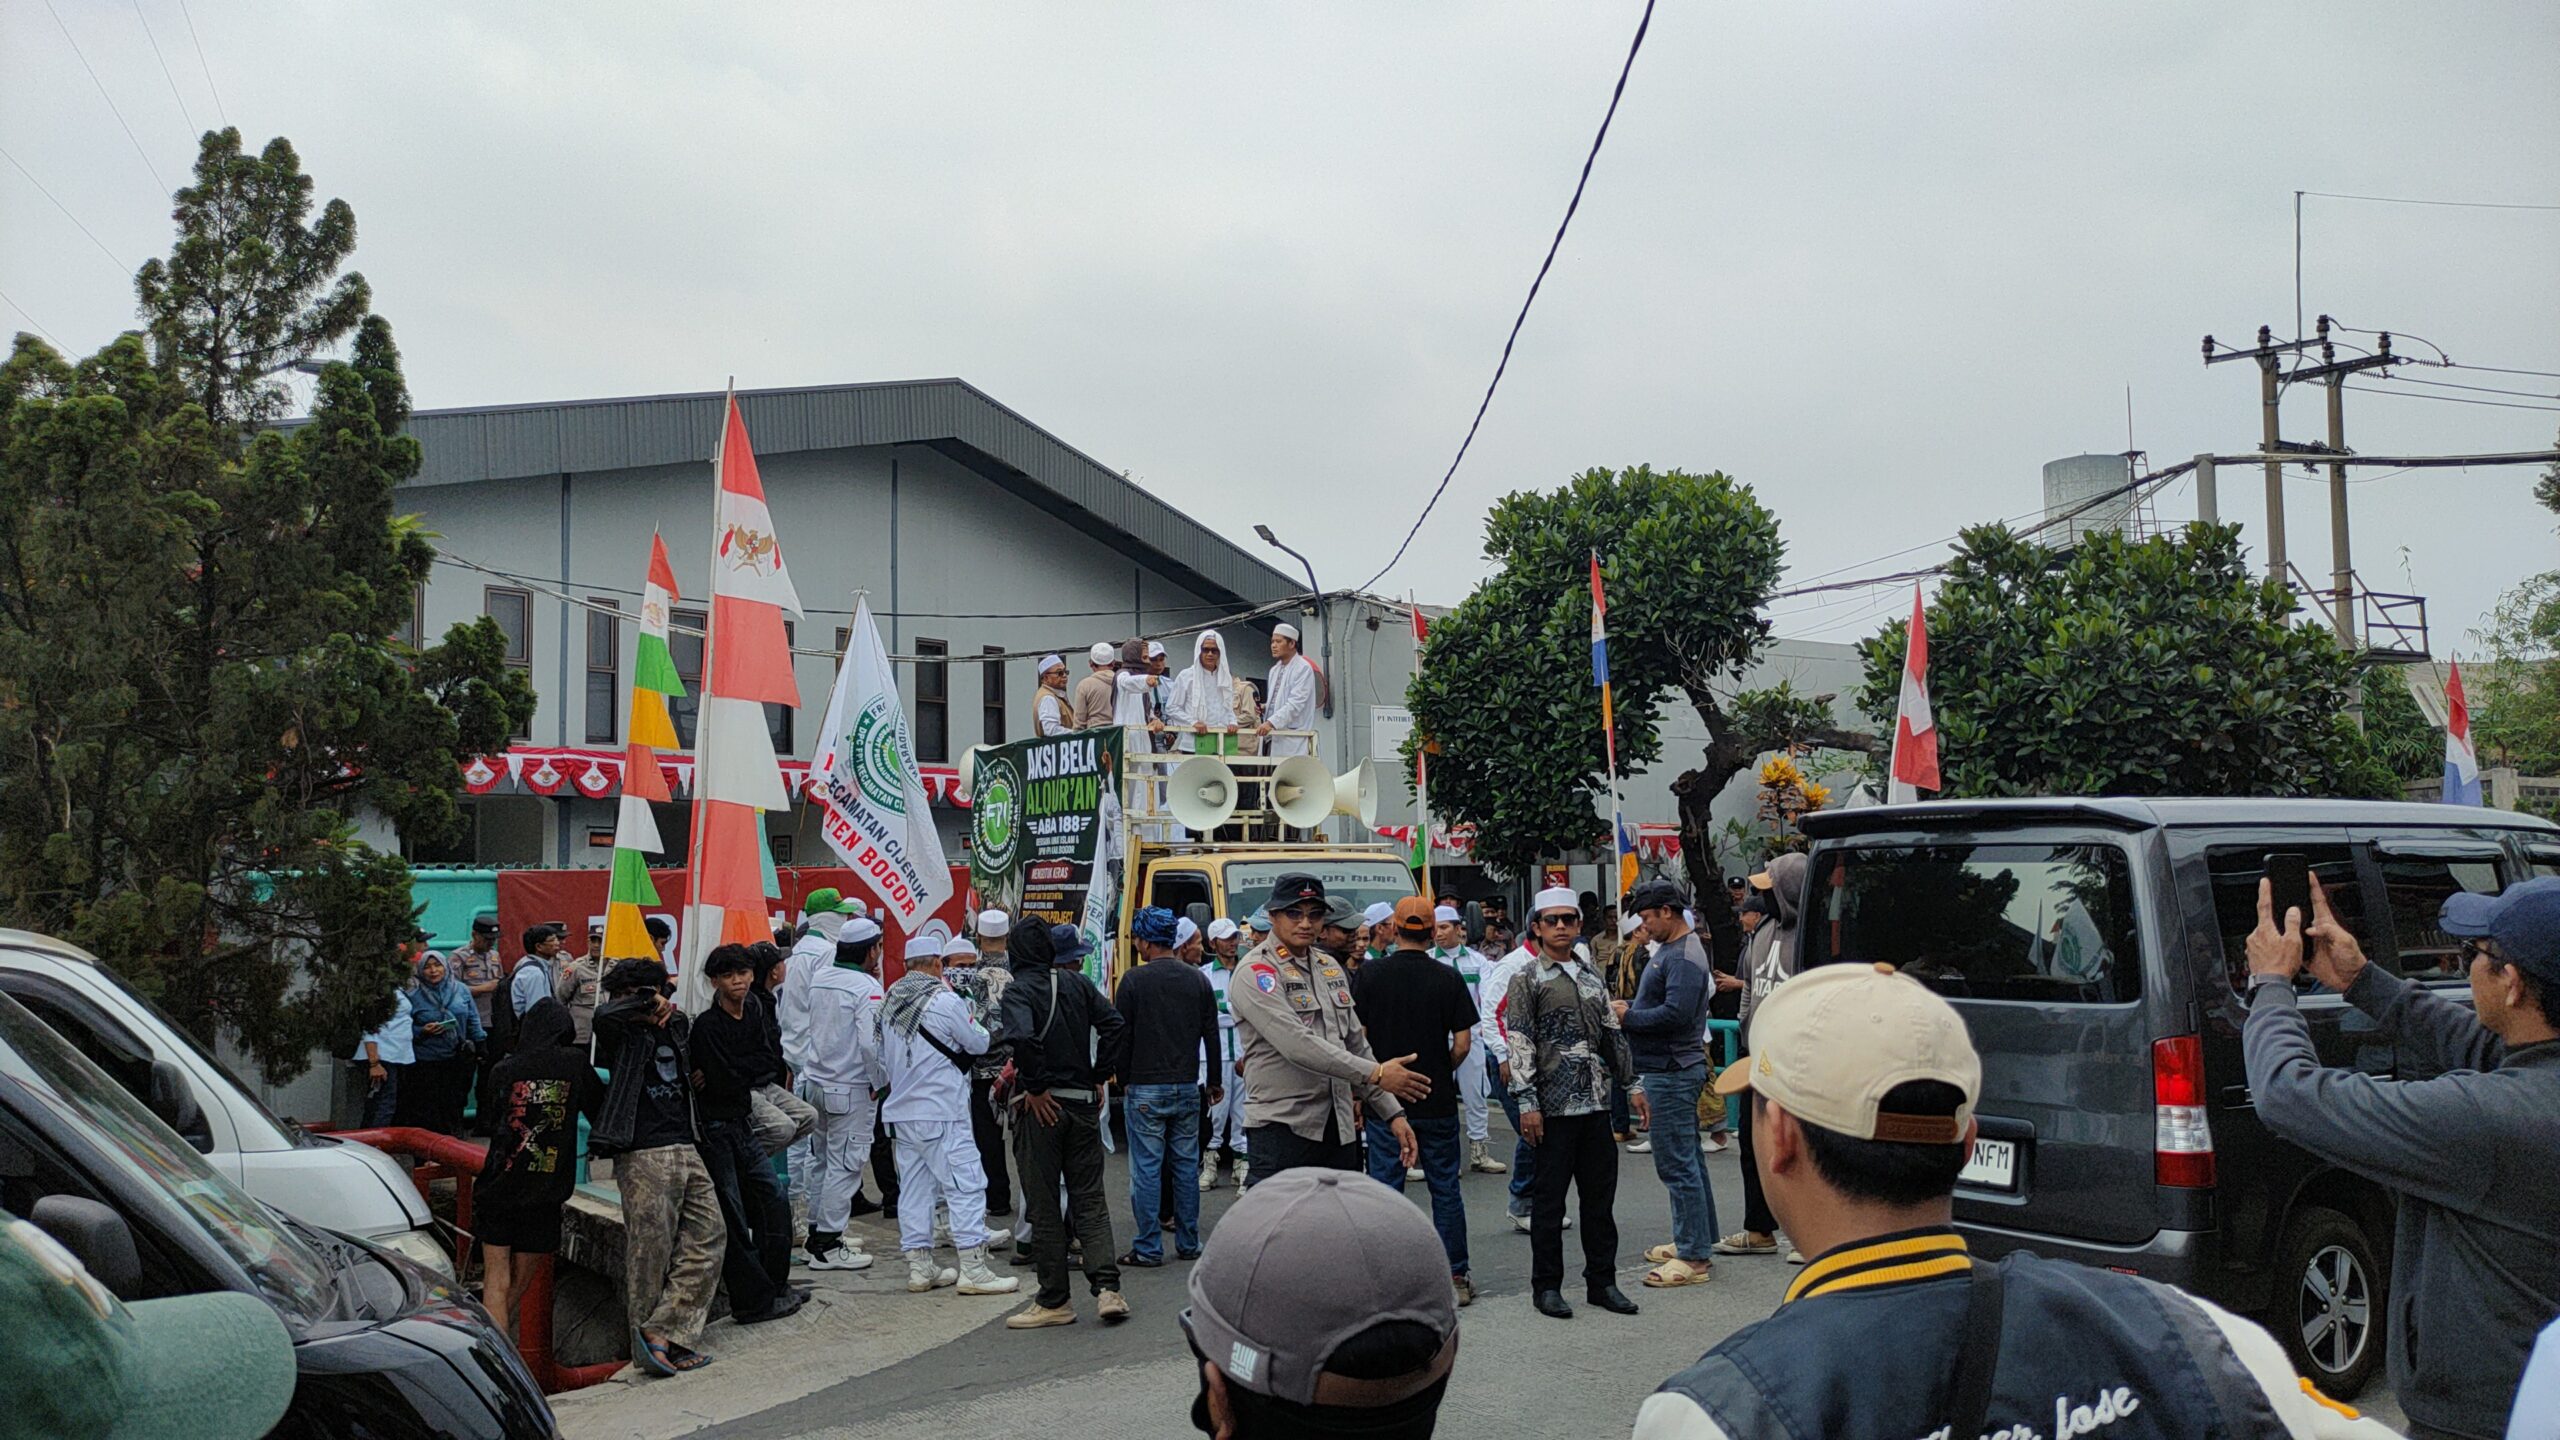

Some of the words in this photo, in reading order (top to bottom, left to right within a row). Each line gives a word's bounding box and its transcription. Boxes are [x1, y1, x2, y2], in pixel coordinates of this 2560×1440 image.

[1026, 743, 1057, 780] AKSI
[1059, 738, 1098, 775] BELA
[1025, 775, 1097, 816] ALQUR'AN
[828, 774, 889, 842] ECAMATAN
[884, 840, 929, 904] CIJERUK
[1037, 816, 1058, 835] ABA
[1058, 815, 1080, 833] 188
[857, 846, 916, 917] BOGOR
